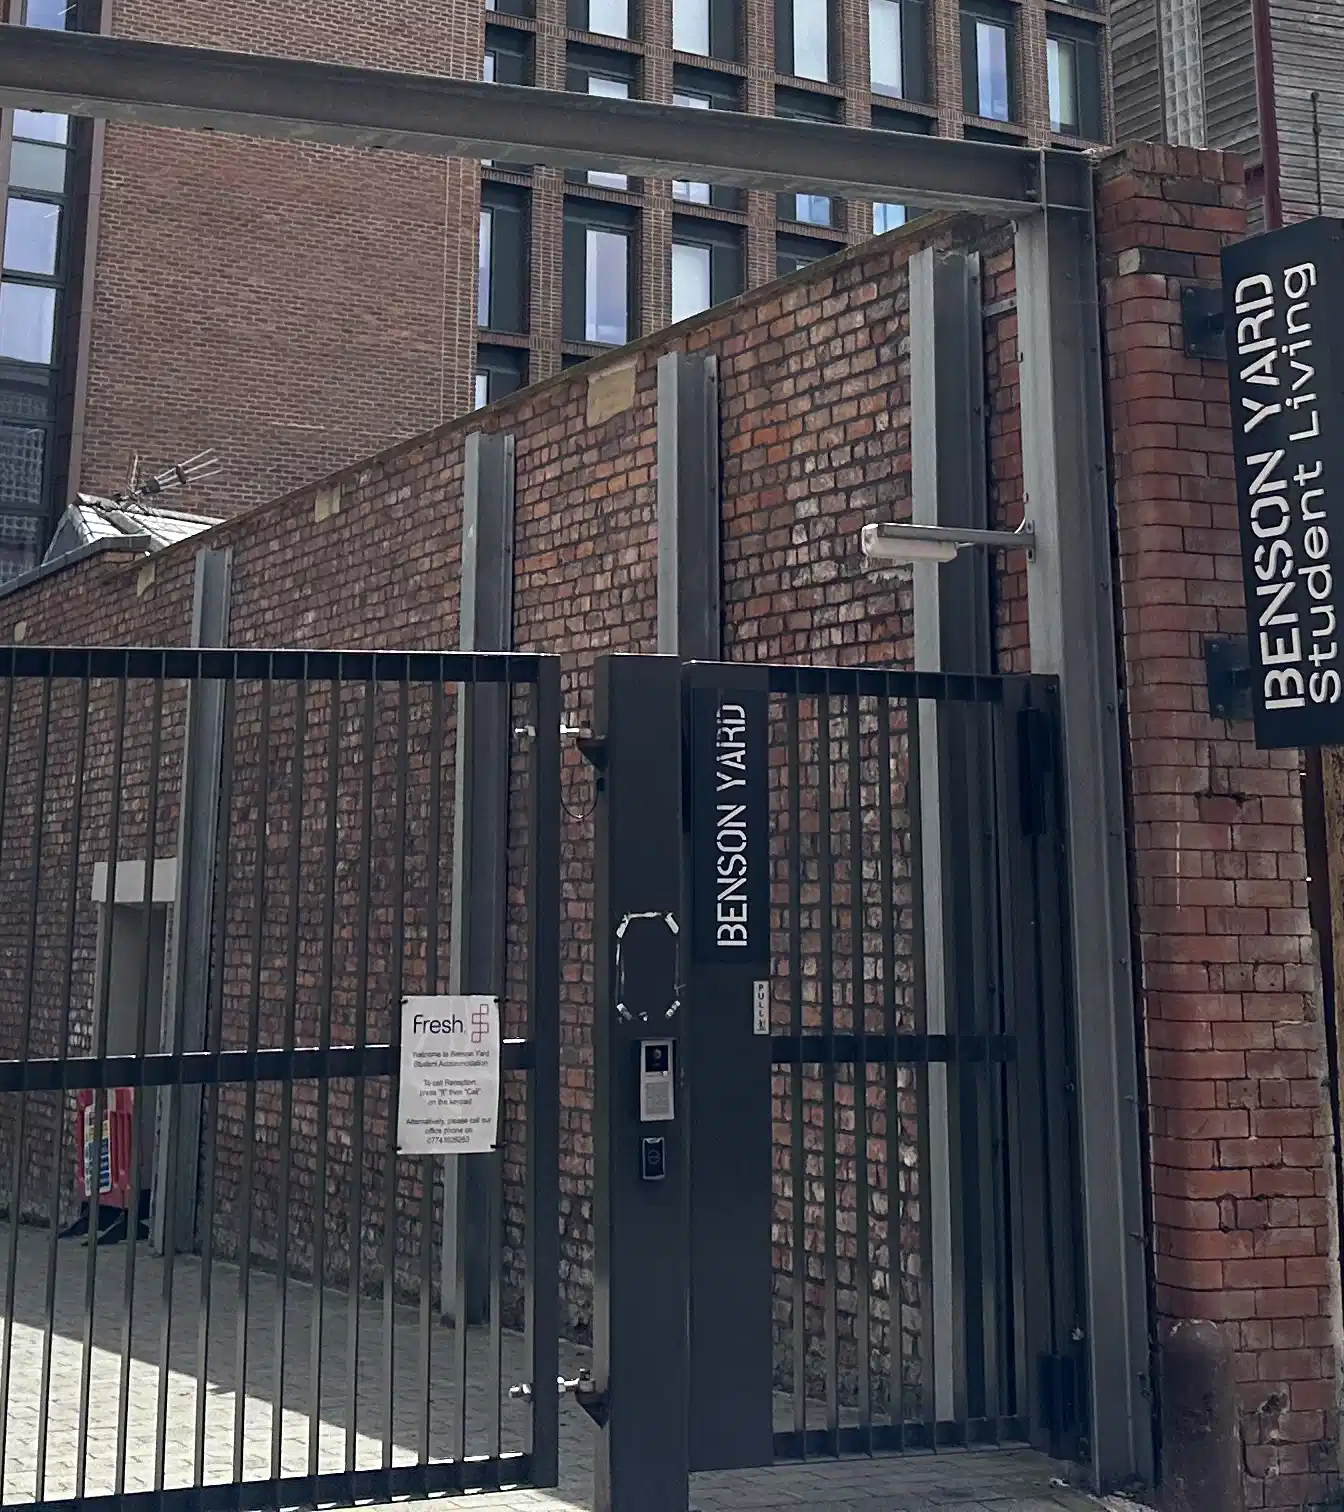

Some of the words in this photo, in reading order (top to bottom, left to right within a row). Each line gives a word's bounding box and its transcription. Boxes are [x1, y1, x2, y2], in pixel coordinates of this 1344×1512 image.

[1234, 272, 1282, 434] YARD
[1282, 261, 1321, 442] Living
[1246, 448, 1306, 711] BENSON
[1294, 459, 1342, 705] Student
[716, 704, 747, 792] YARD
[716, 804, 748, 947] BENSON
[413, 1014, 464, 1034] Fresh
